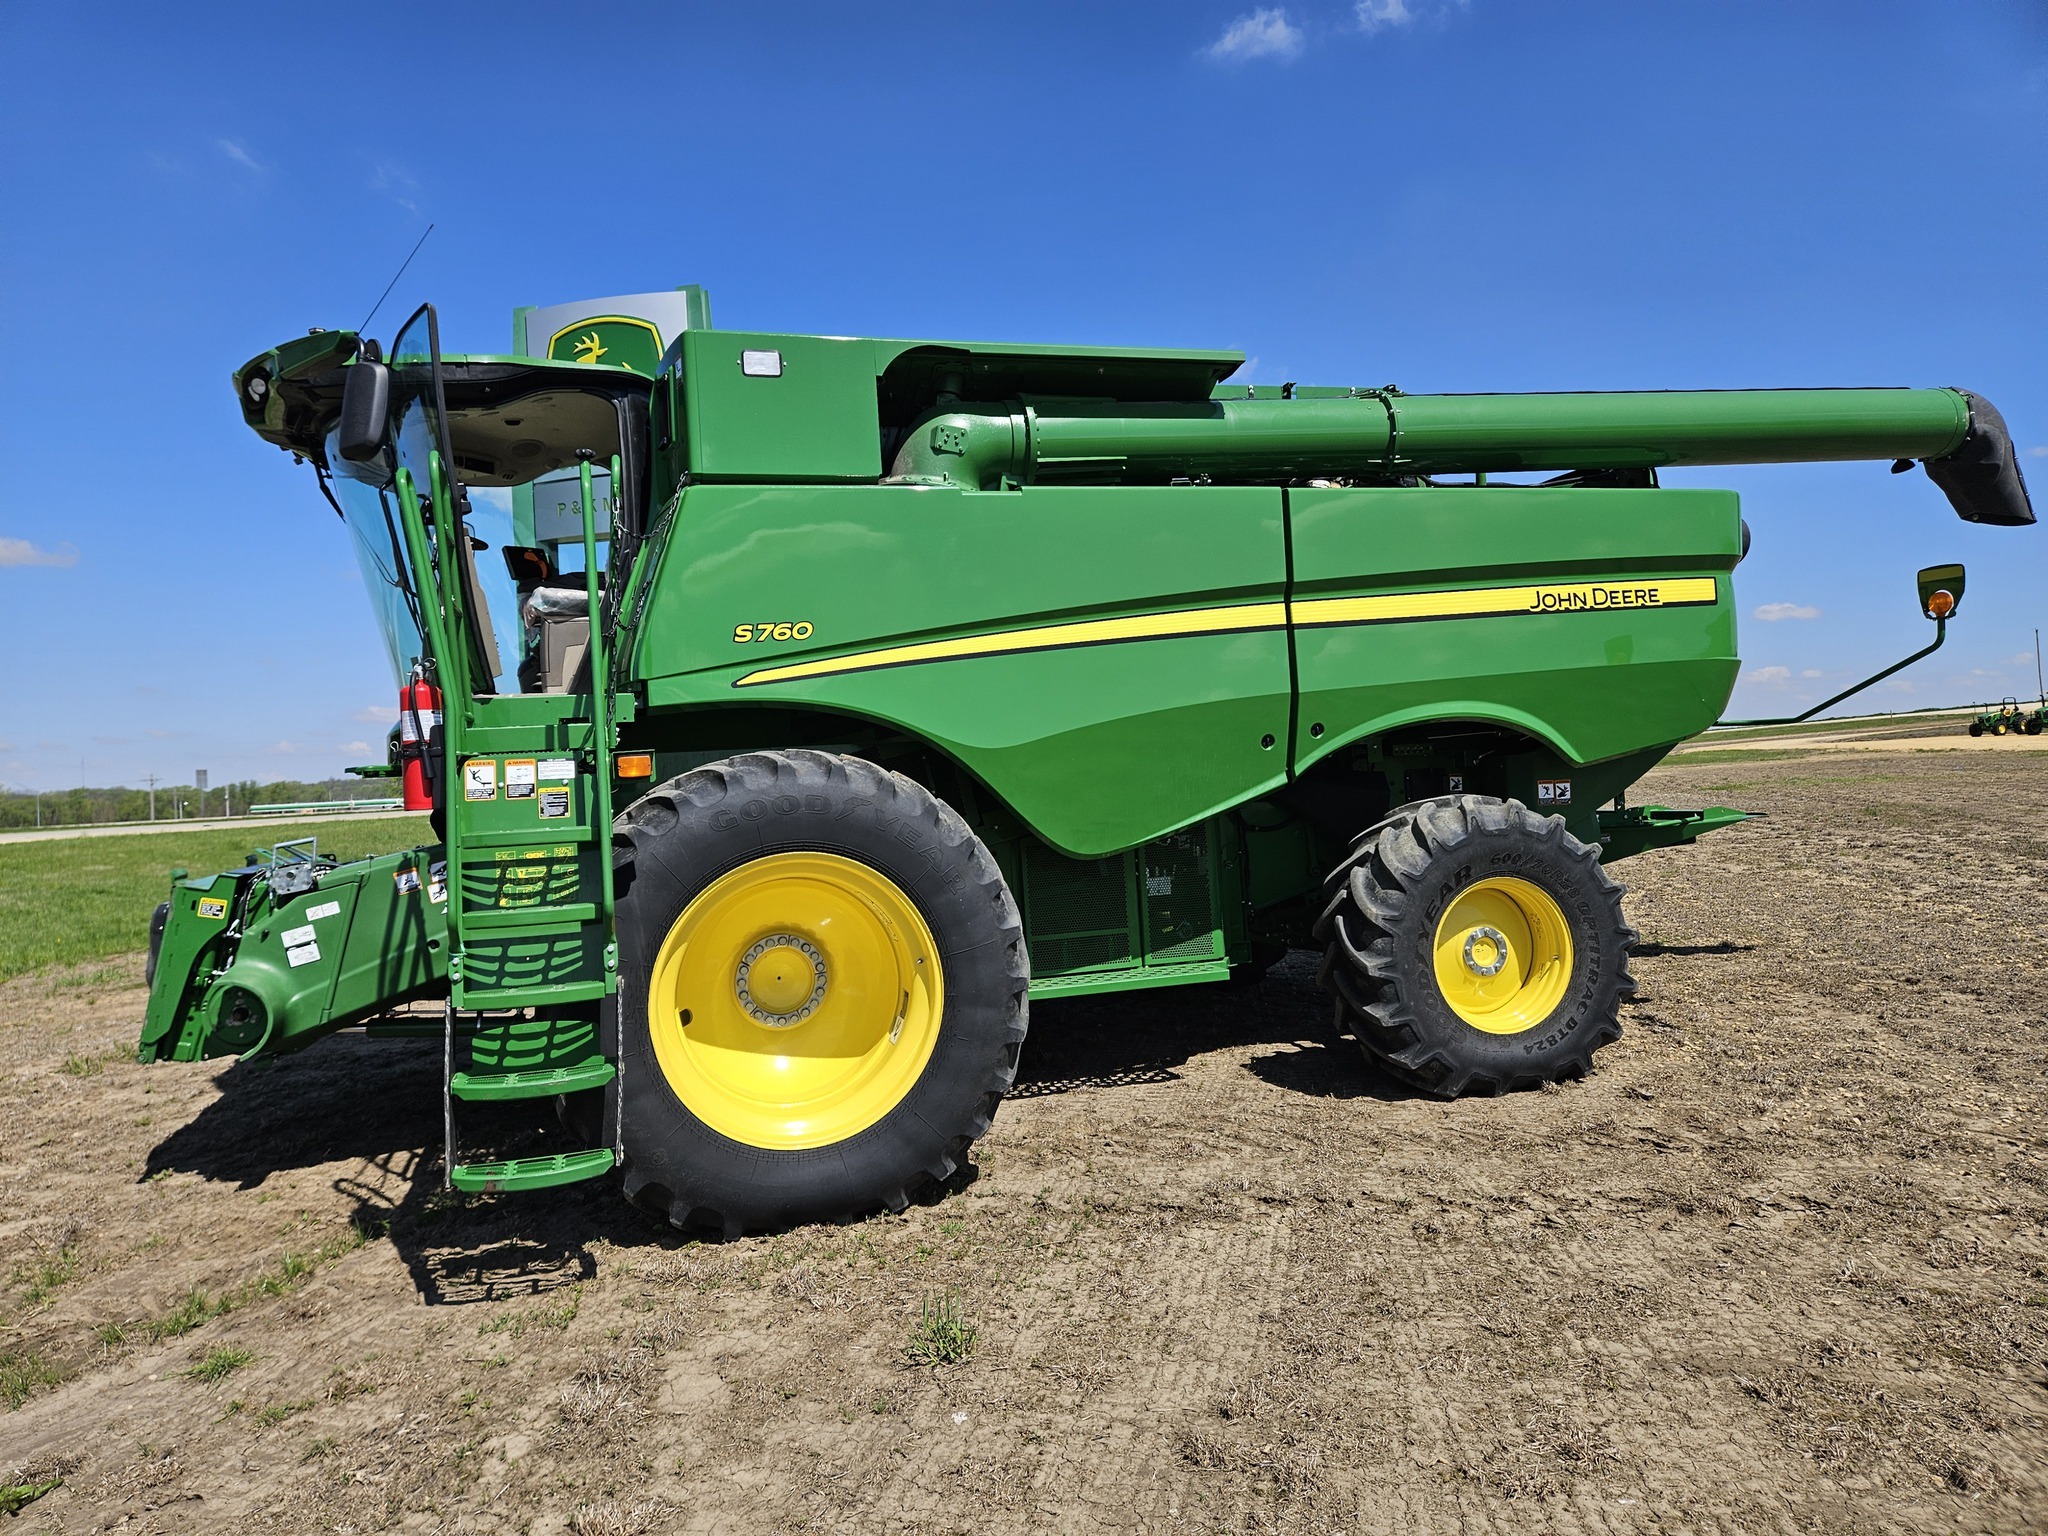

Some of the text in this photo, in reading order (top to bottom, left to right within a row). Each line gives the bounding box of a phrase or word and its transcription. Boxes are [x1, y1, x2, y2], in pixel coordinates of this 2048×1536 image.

[557, 502, 567, 517] P
[571, 500, 582, 515] &
[1530, 588, 1661, 609] JOHN DEERE
[733, 621, 814, 643] S760
[1576, 900, 1601, 1015] OPTITRAC
[1523, 1015, 1579, 1056] DT824
